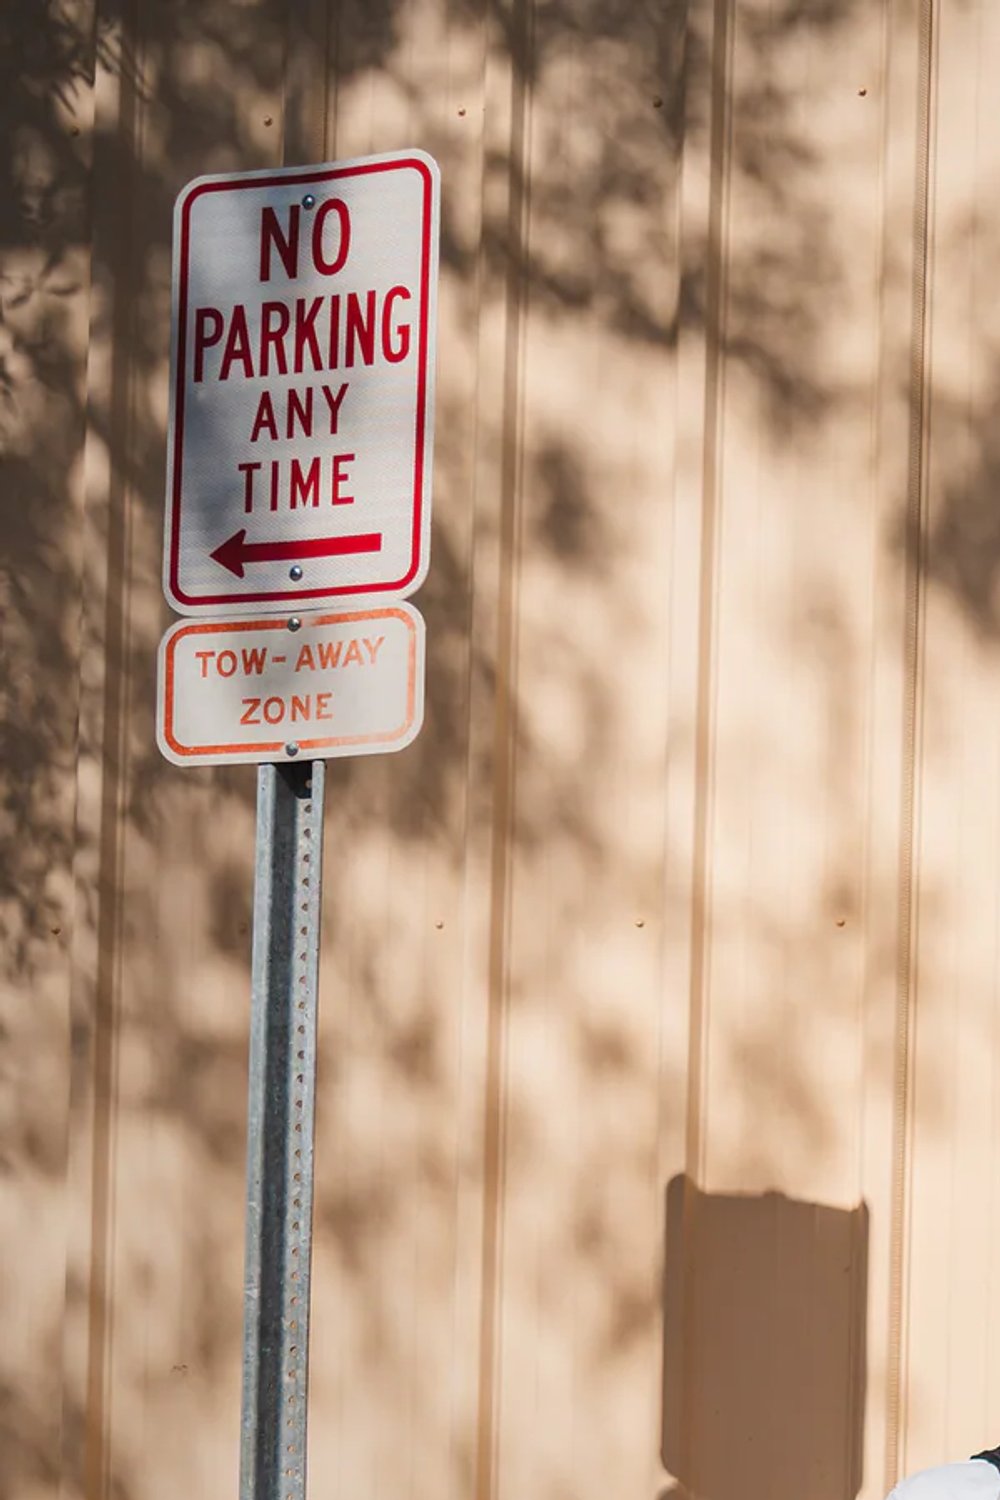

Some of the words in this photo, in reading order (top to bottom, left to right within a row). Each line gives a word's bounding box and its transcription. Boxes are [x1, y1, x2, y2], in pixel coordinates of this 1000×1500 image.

[259, 198, 351, 282] NO
[193, 286, 411, 383] PARKING
[250, 383, 349, 443] ANY
[238, 454, 357, 513] TIME
[195, 636, 386, 679] TOW-AWAY
[240, 692, 333, 726] ZONE
